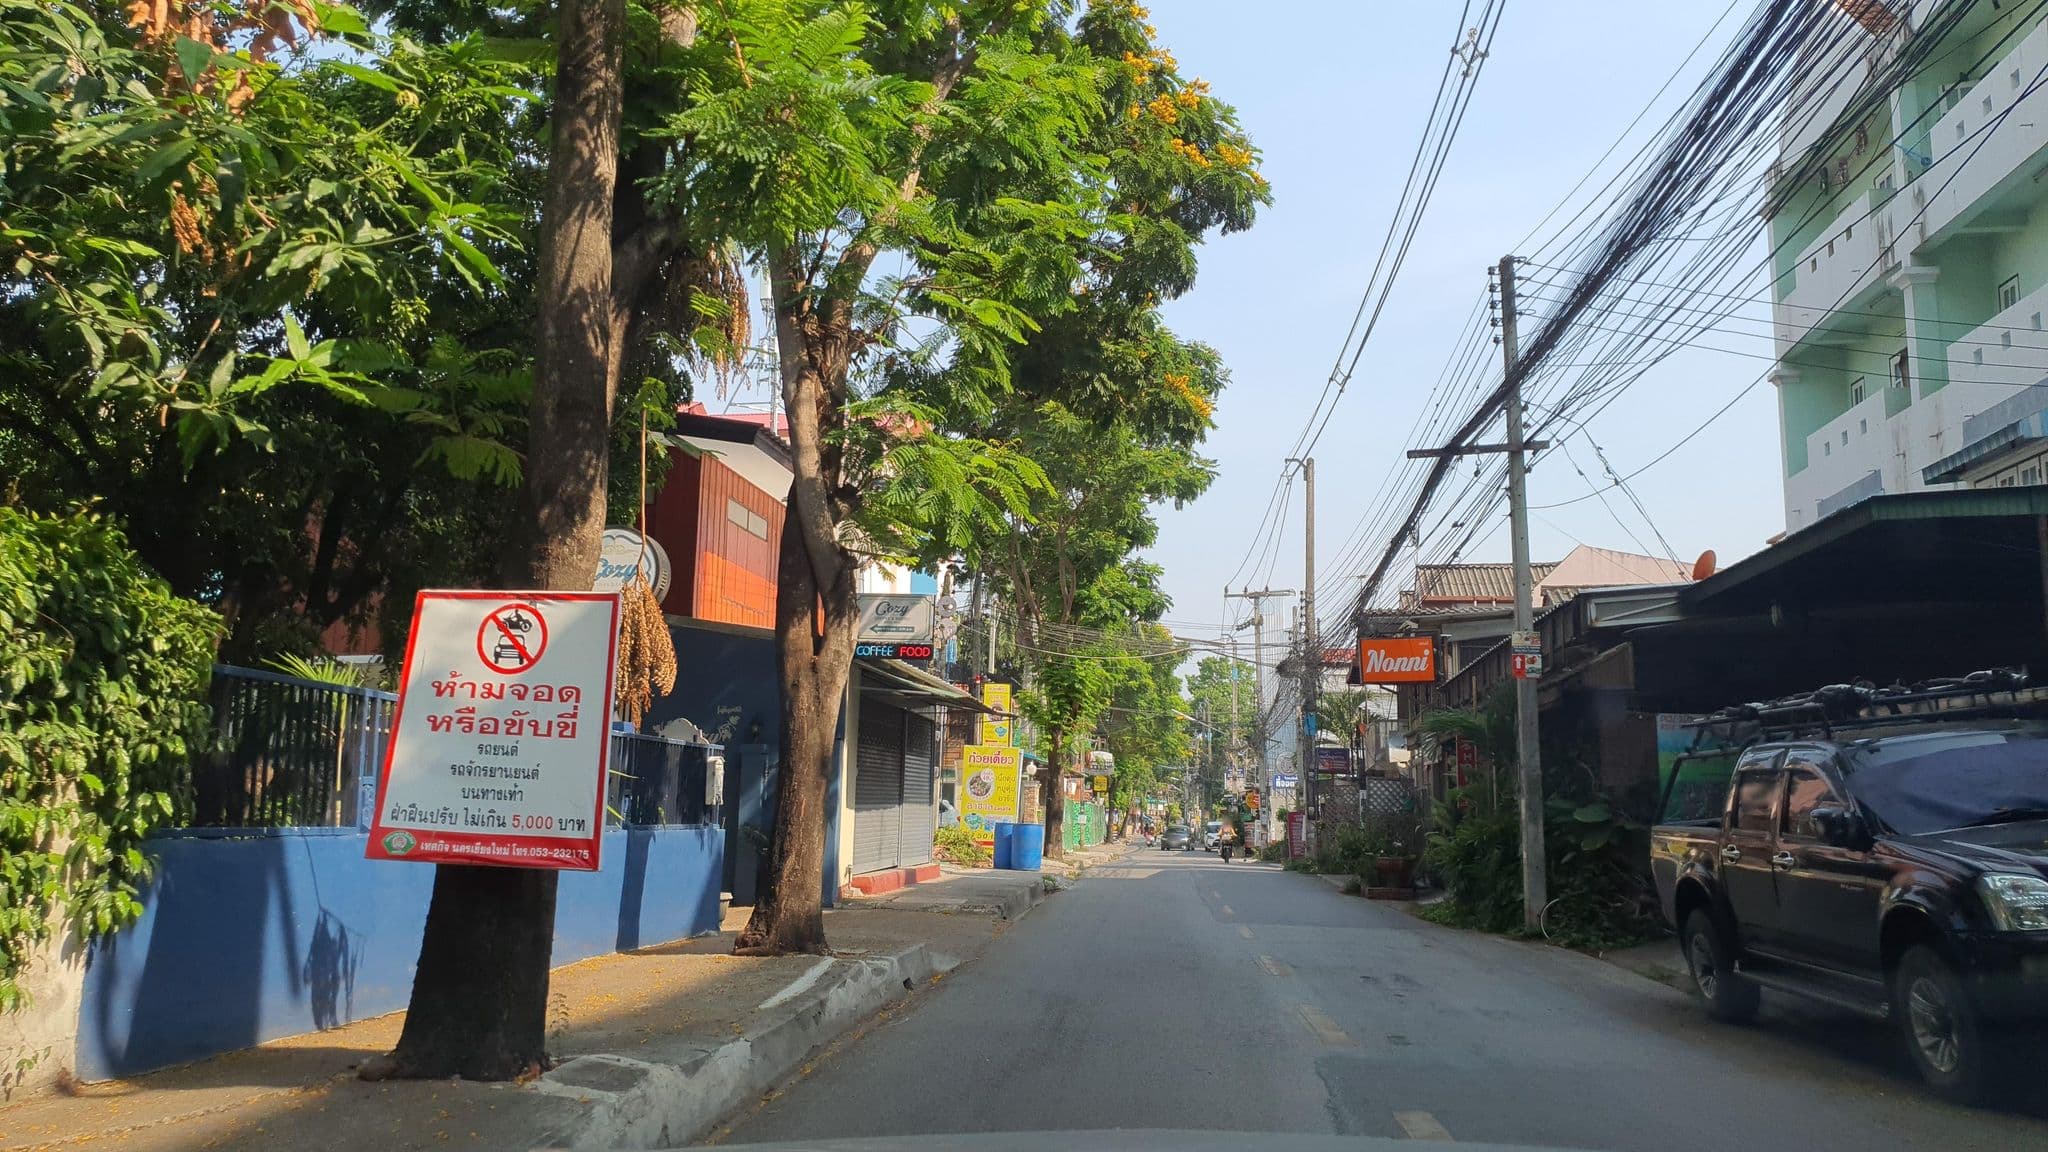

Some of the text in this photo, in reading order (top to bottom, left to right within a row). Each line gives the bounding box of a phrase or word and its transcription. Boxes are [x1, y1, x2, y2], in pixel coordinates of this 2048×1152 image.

[875, 601, 909, 617] Cozy
[856, 645, 931, 657] COFFEE FOOD
[1366, 648, 1430, 673] Nonni
[431, 670, 581, 704] ห้ามจอด
[426, 704, 579, 739] หรือขับขี่
[477, 740, 520, 757] รถยนต์
[450, 760, 541, 780] รถจักรยานยนต์
[461, 783, 524, 801] บนทางเท้า
[390, 803, 586, 832] ฝ่าฝืนปรับ ไม่เกิน 5,000 บาท
